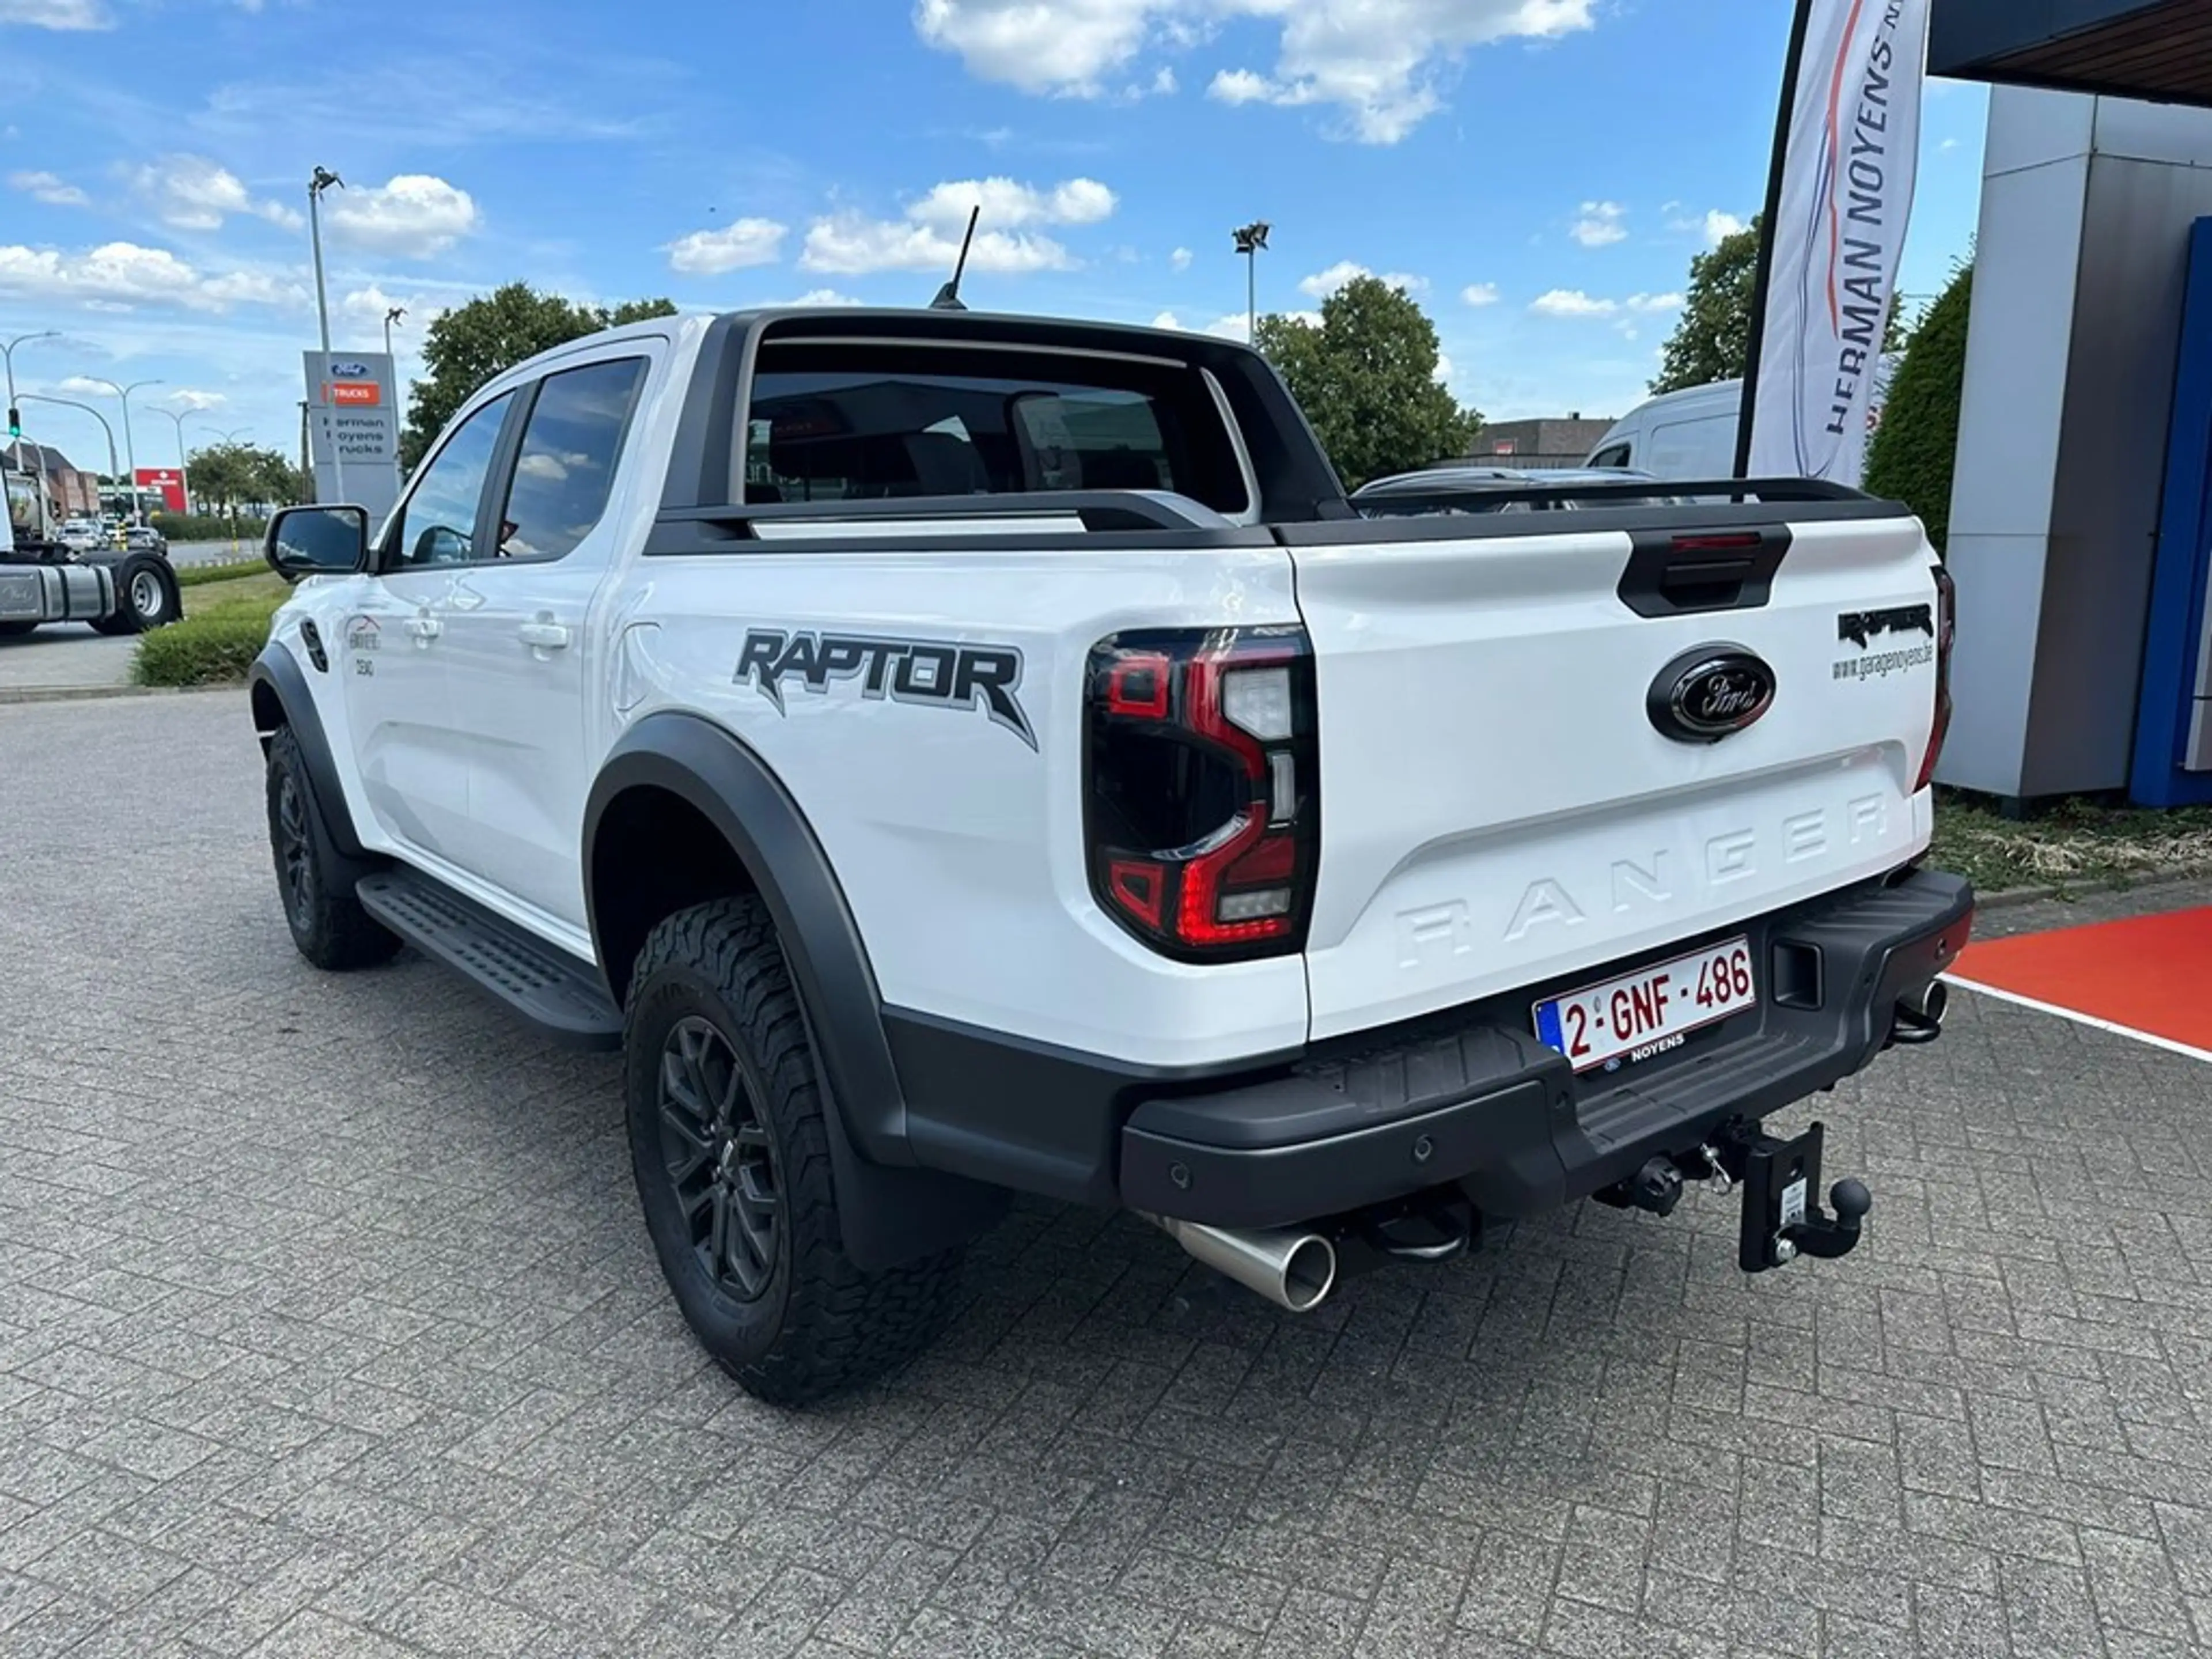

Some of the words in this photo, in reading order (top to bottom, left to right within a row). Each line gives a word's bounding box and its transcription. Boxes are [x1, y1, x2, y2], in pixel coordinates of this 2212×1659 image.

[1847, 35, 1892, 226] NOYENS
[1825, 238, 1883, 435] HERMAN
[334, 388, 370, 399] TRUCKS
[329, 443, 382, 454] rucks
[732, 628, 1039, 753] RAPTOR
[1702, 673, 1757, 717] Ford
[1394, 790, 1887, 968] RANGER
[1631, 1033, 1685, 1062] NOYENS
